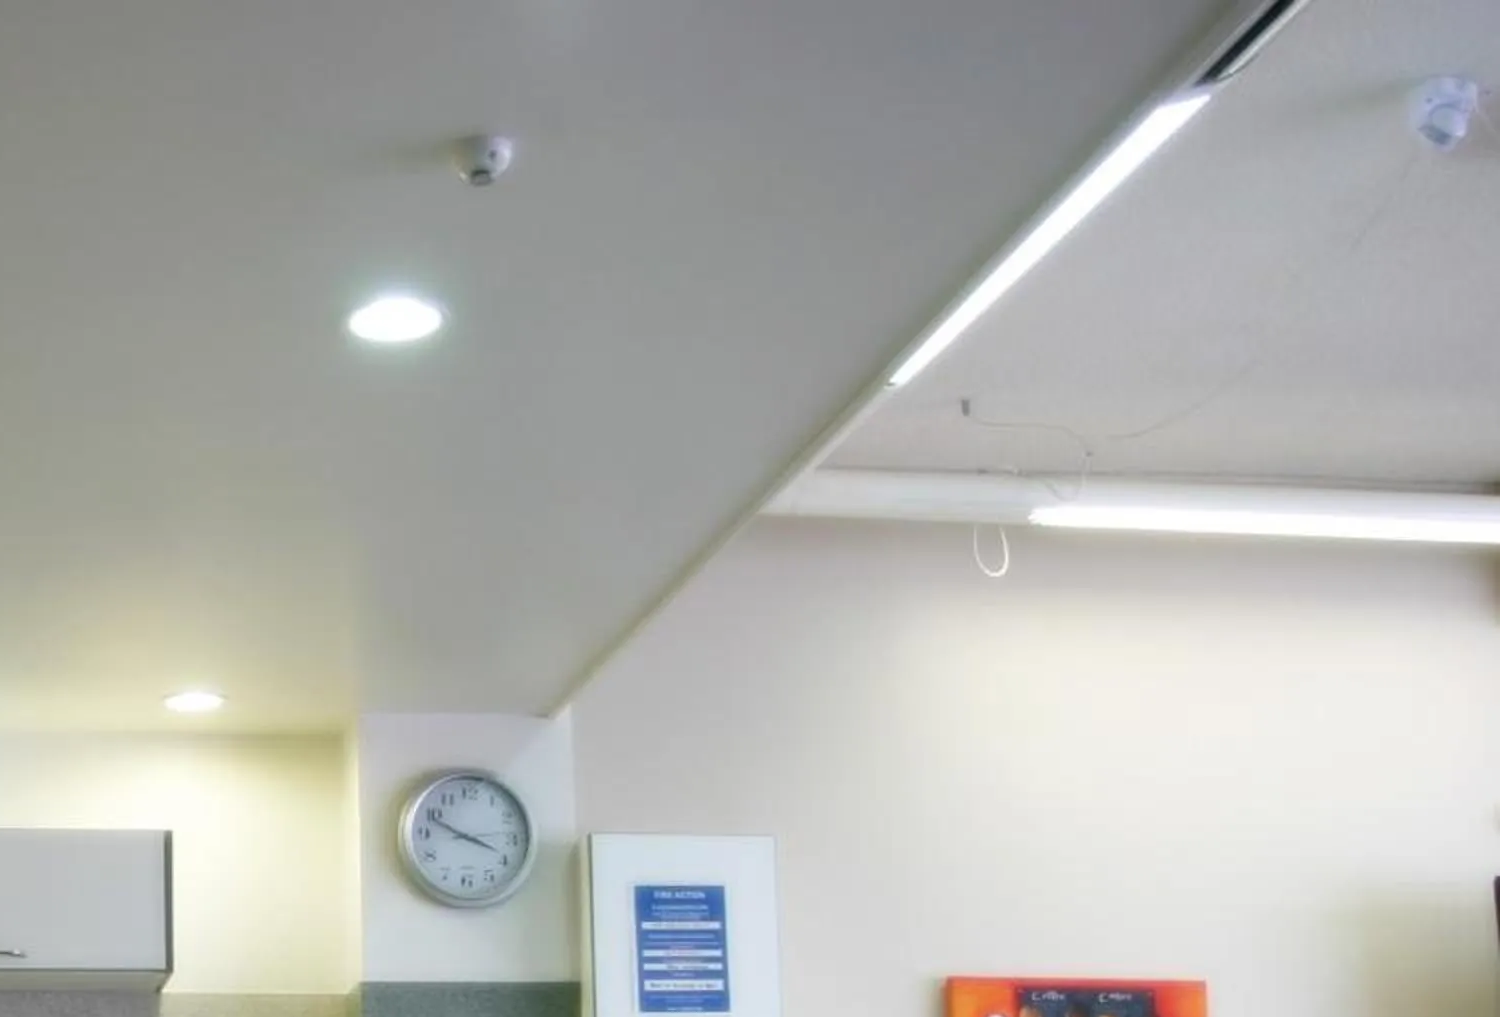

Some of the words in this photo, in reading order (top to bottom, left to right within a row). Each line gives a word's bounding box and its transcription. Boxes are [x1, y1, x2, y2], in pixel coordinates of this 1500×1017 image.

[441, 792, 455, 807] 11
[461, 784, 479, 802] 12
[497, 853, 508, 867] 4
[460, 873, 474, 888] 6
